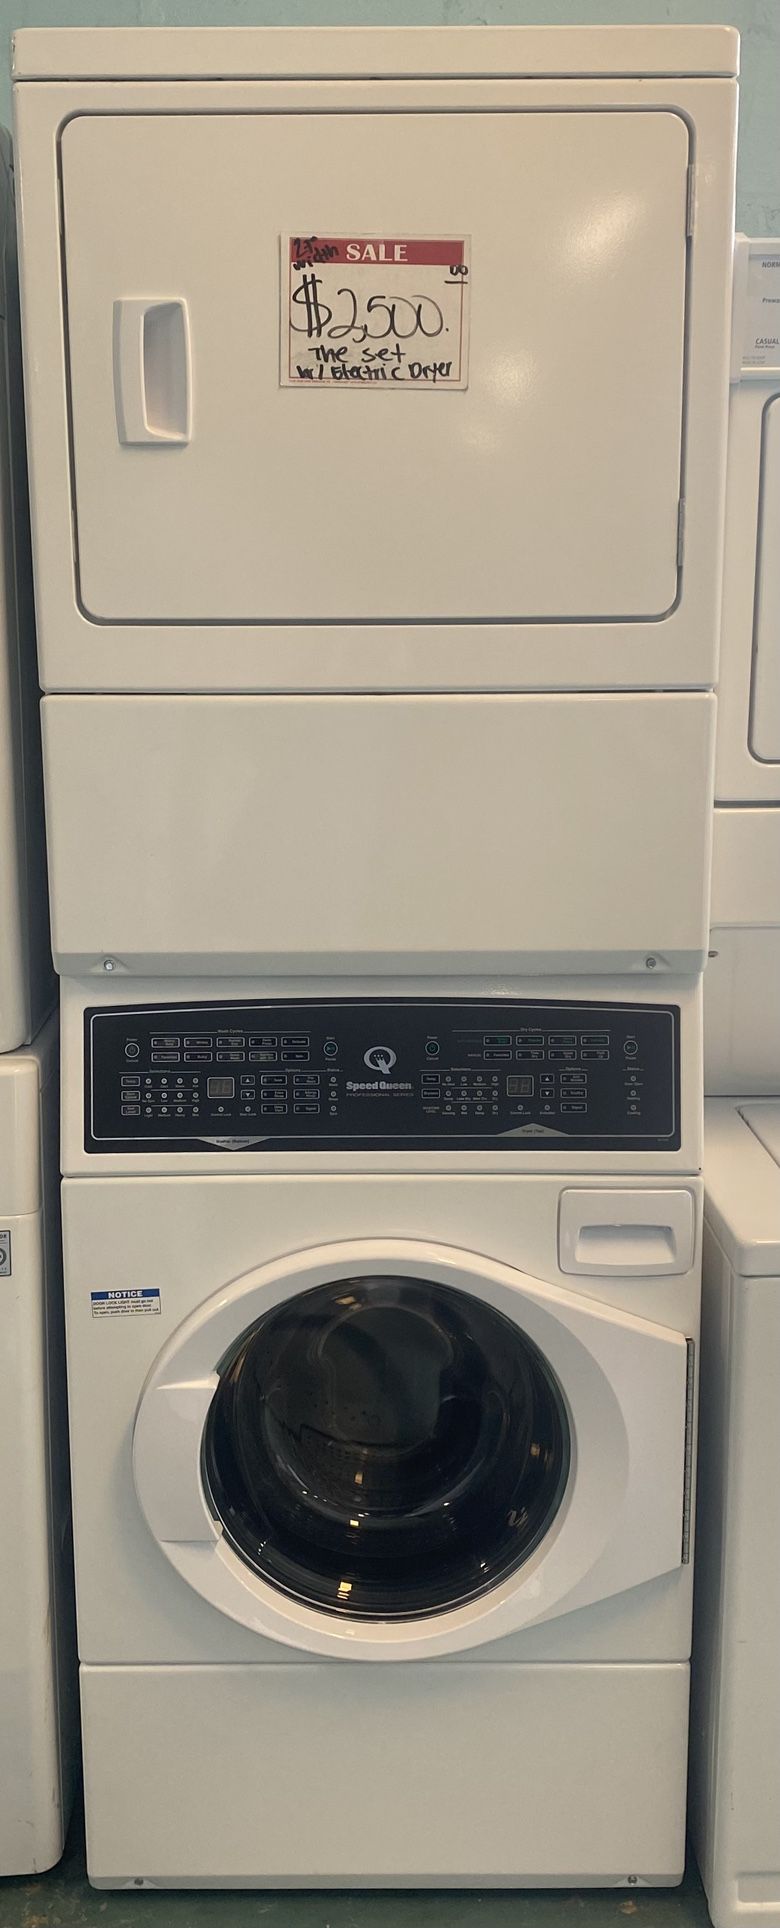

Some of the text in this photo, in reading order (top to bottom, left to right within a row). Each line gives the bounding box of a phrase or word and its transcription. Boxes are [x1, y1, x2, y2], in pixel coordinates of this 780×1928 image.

[346, 244, 408, 261] SALE
[362, 344, 406, 362] set
[331, 364, 404, 381] Electric
[408, 362, 452, 383] Dryer
[346, 1081, 412, 1091] Speed Queen
